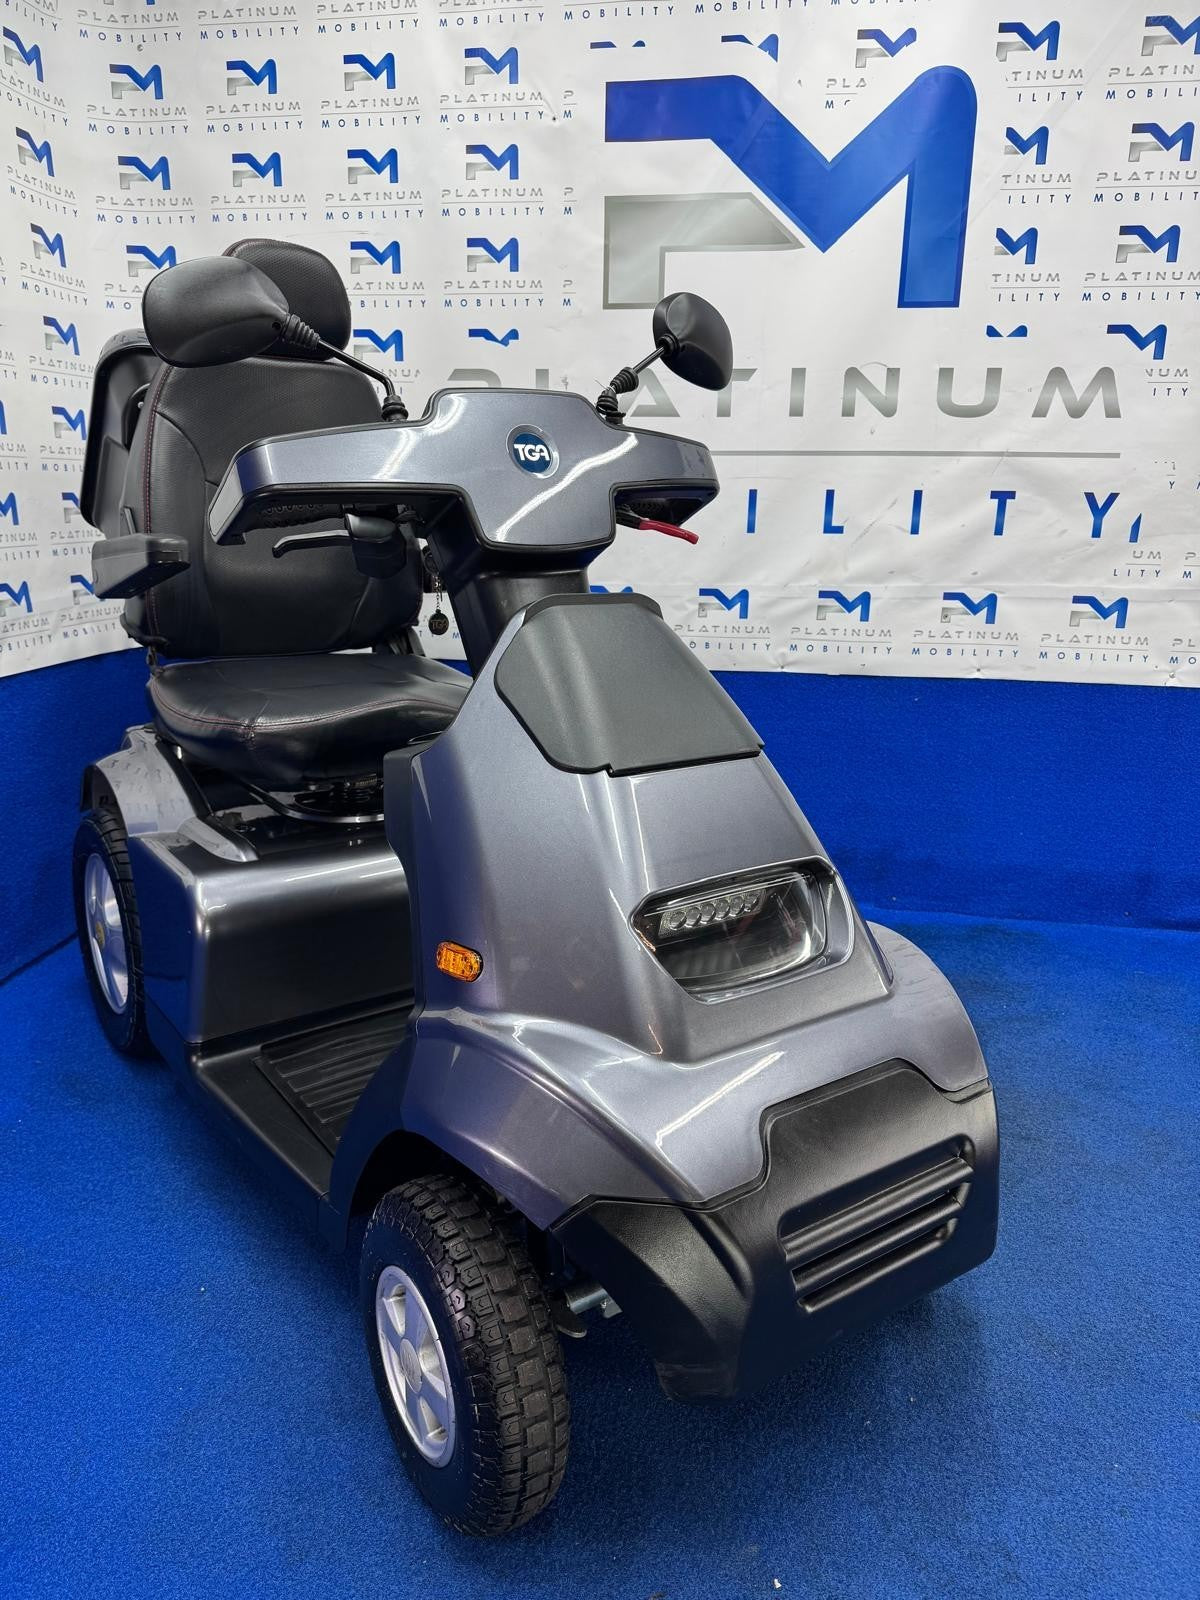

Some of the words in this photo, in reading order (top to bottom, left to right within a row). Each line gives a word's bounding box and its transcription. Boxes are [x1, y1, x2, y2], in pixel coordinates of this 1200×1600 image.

[77, 10, 180, 23] PLATINUM
[198, 6, 297, 19] PLATINUM
[564, 6, 674, 20] MOBILITY
[318, 19, 418, 33] MOBILITY
[439, 13, 544, 27] MOBILITY
[79, 29, 182, 43] MOBILITY
[200, 26, 299, 40] MOBILITY
[321, 96, 419, 109] PLATINUM
[440, 92, 543, 104] PLATINUM
[86, 105, 187, 117] PLATINUM
[206, 102, 301, 114] PLATINUM
[321, 116, 420, 128] MOBILITY
[440, 111, 544, 123] MOBILITY
[88, 123, 189, 136] MOBILITY
[207, 121, 302, 133] MOBILITY
[325, 190, 422, 201] PLATINUM
[441, 187, 543, 197] PLATINUM
[95, 196, 193, 206] PLATINUM
[211, 194, 306, 205] PLATINUM
[212, 211, 308, 222] MOBILITY
[326, 209, 424, 220] MOBILITY
[442, 206, 544, 217] MOBILITY
[97, 214, 196, 224] MOBILITY
[444, 279, 543, 289] PLATINUM
[444, 298, 545, 308] MOBILITY
[514, 443, 550, 461] TGA
[790, 627, 892, 638] PLATINUM
[913, 630, 1019, 641] PLATINUM
[1040, 633, 1149, 646] PLATINUM
[790, 644, 892, 654] MOBILITY
[912, 648, 1018, 658] MOBILITY
[1038, 651, 1149, 663] MOBILITY
